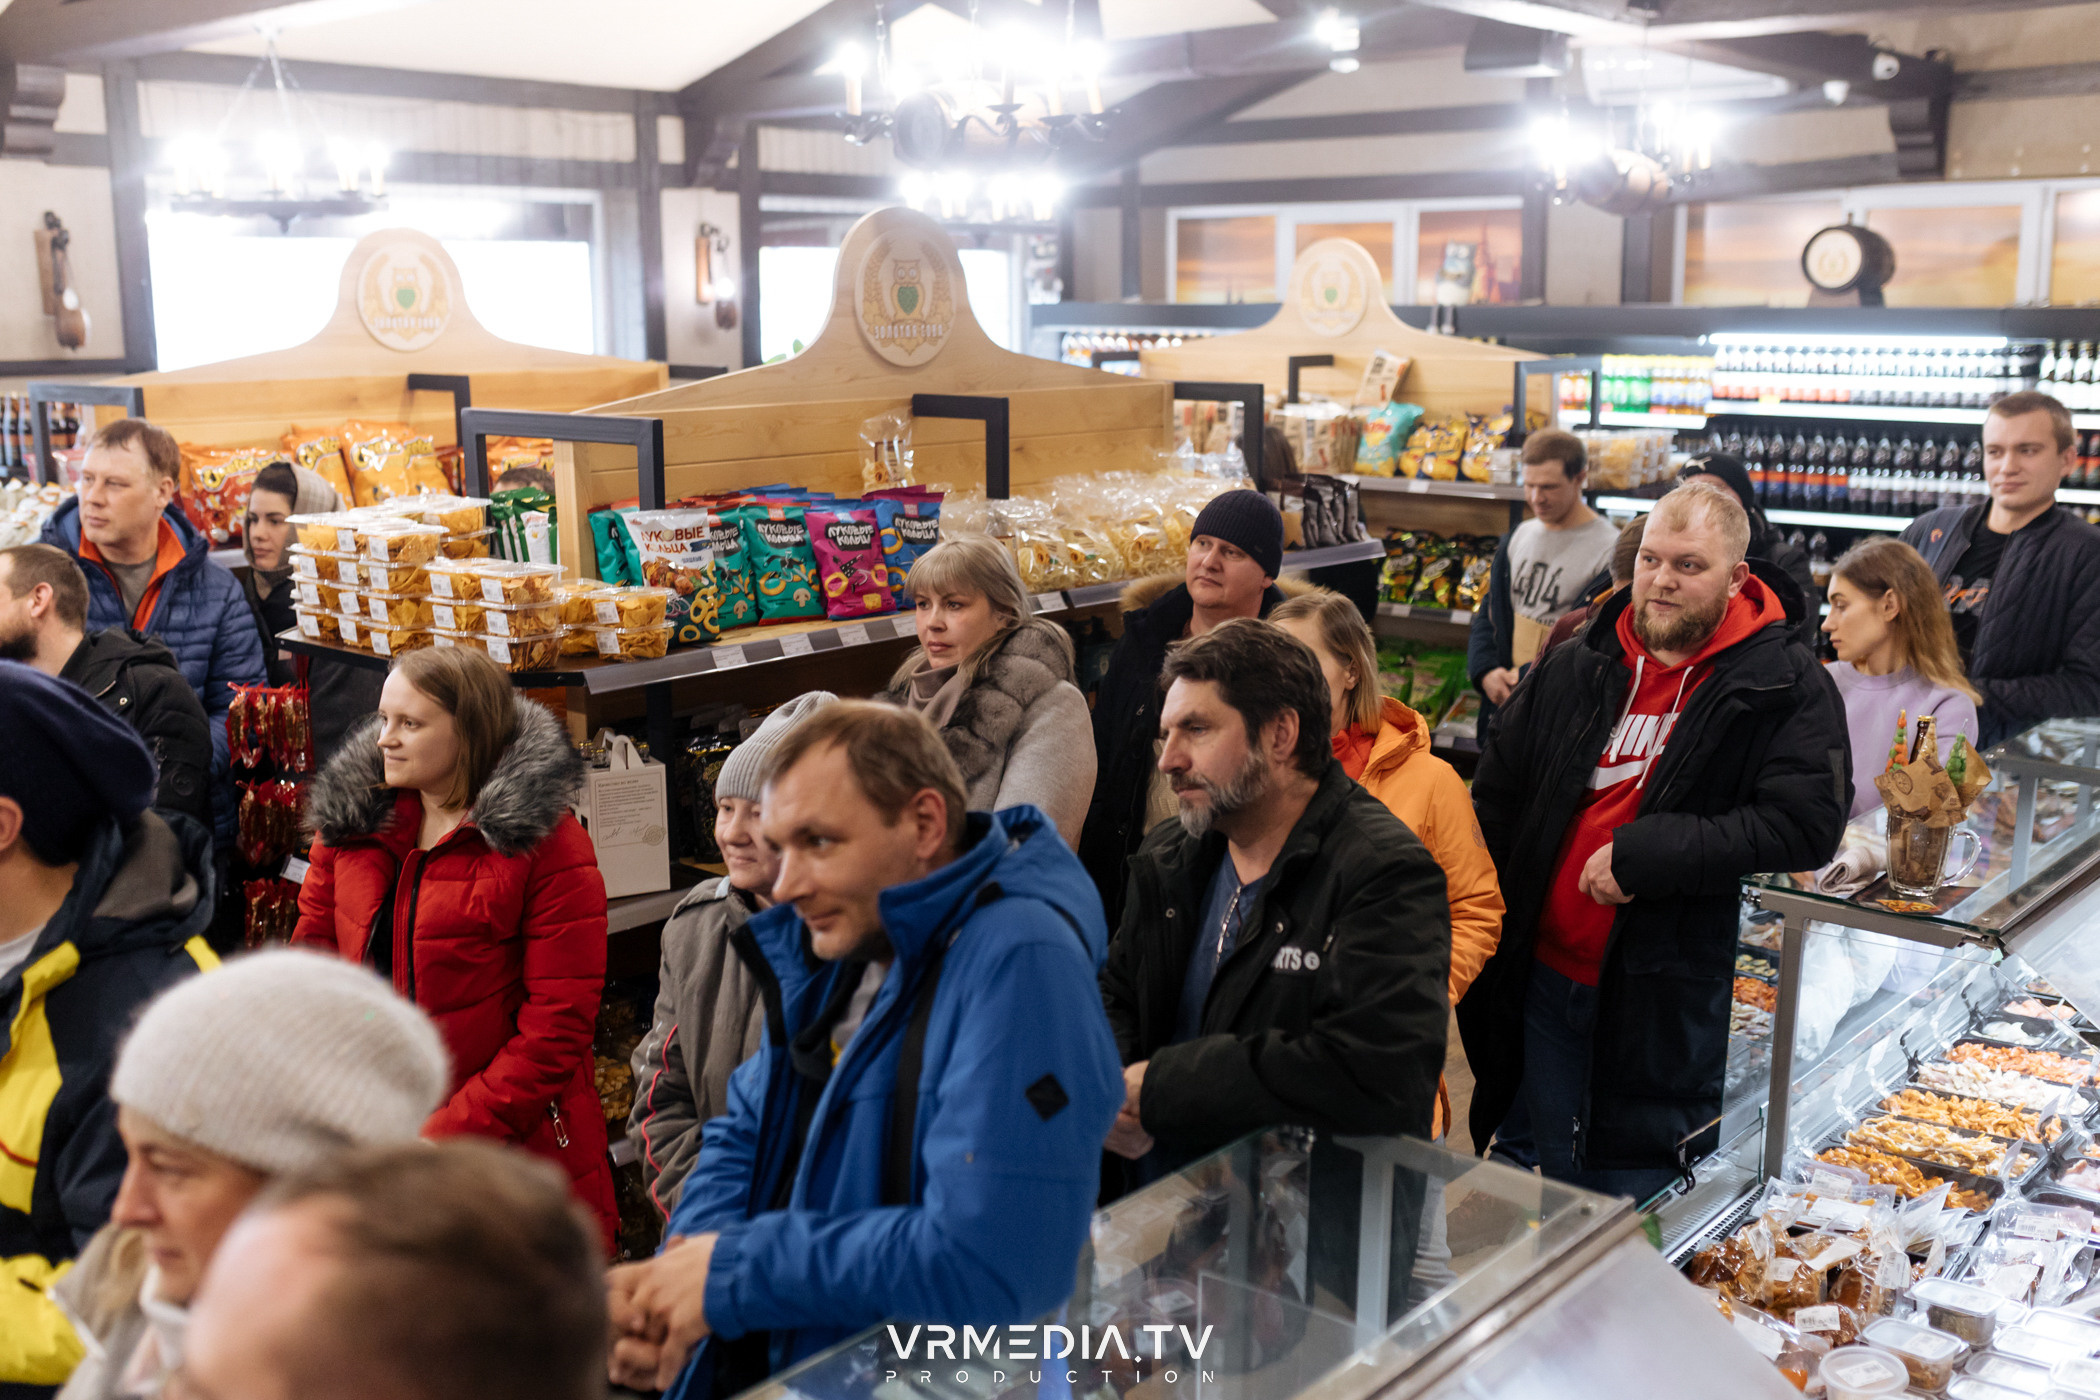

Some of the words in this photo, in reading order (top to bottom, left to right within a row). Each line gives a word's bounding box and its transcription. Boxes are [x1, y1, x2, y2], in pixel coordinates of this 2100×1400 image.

[757, 523, 804, 535] ЛУКОВЫЕ
[894, 517, 939, 530] ЛУКОВЫЕ
[641, 526, 705, 543] ЛУКОВЫЕ
[828, 525, 875, 538] ЛУКОВЫЕ
[901, 528, 936, 540] КОЛЬЦА
[1513, 560, 1563, 612] 404
